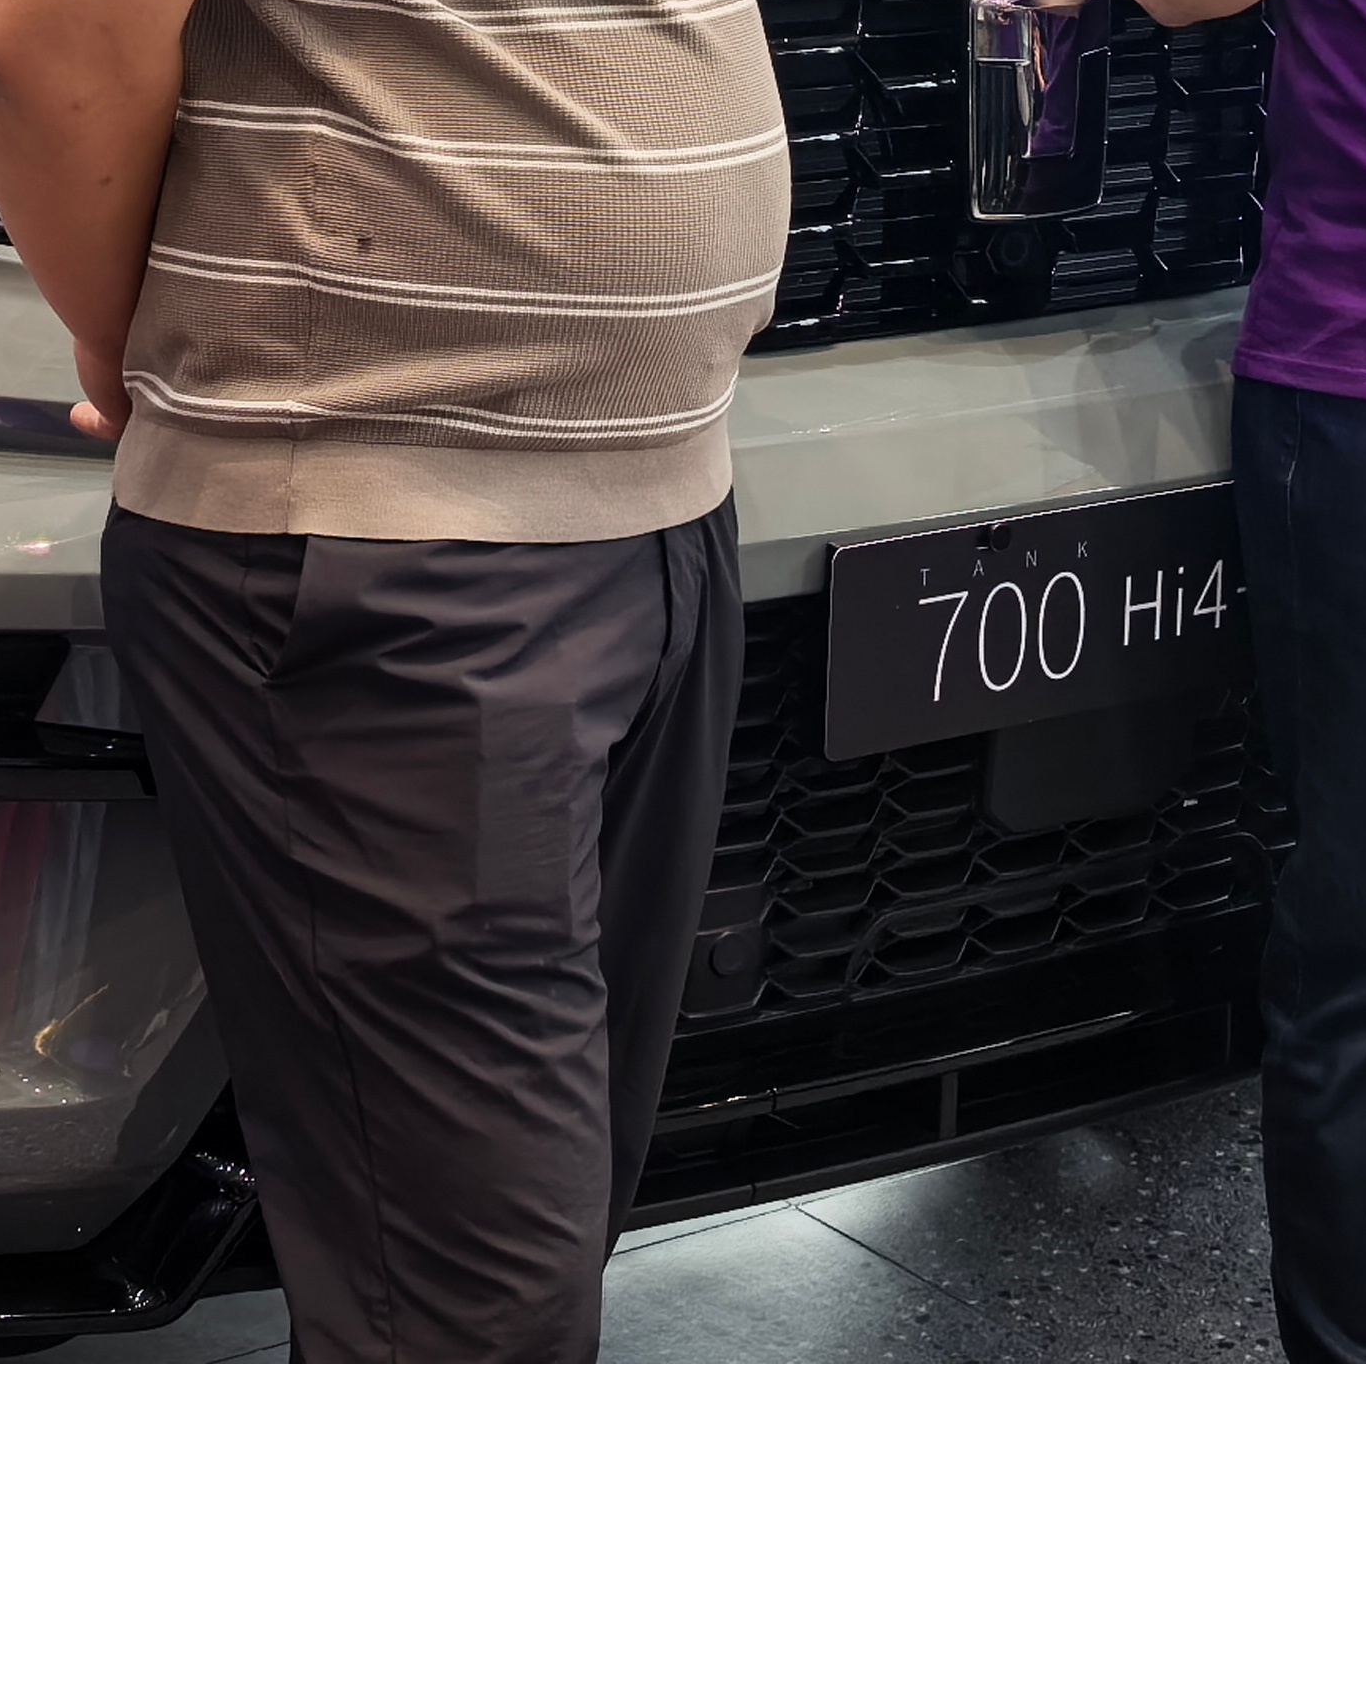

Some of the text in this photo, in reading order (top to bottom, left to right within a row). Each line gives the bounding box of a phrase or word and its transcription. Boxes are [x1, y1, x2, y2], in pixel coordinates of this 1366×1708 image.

[920, 541, 1089, 586] TANK
[918, 559, 1247, 703] 700 Hi4-
